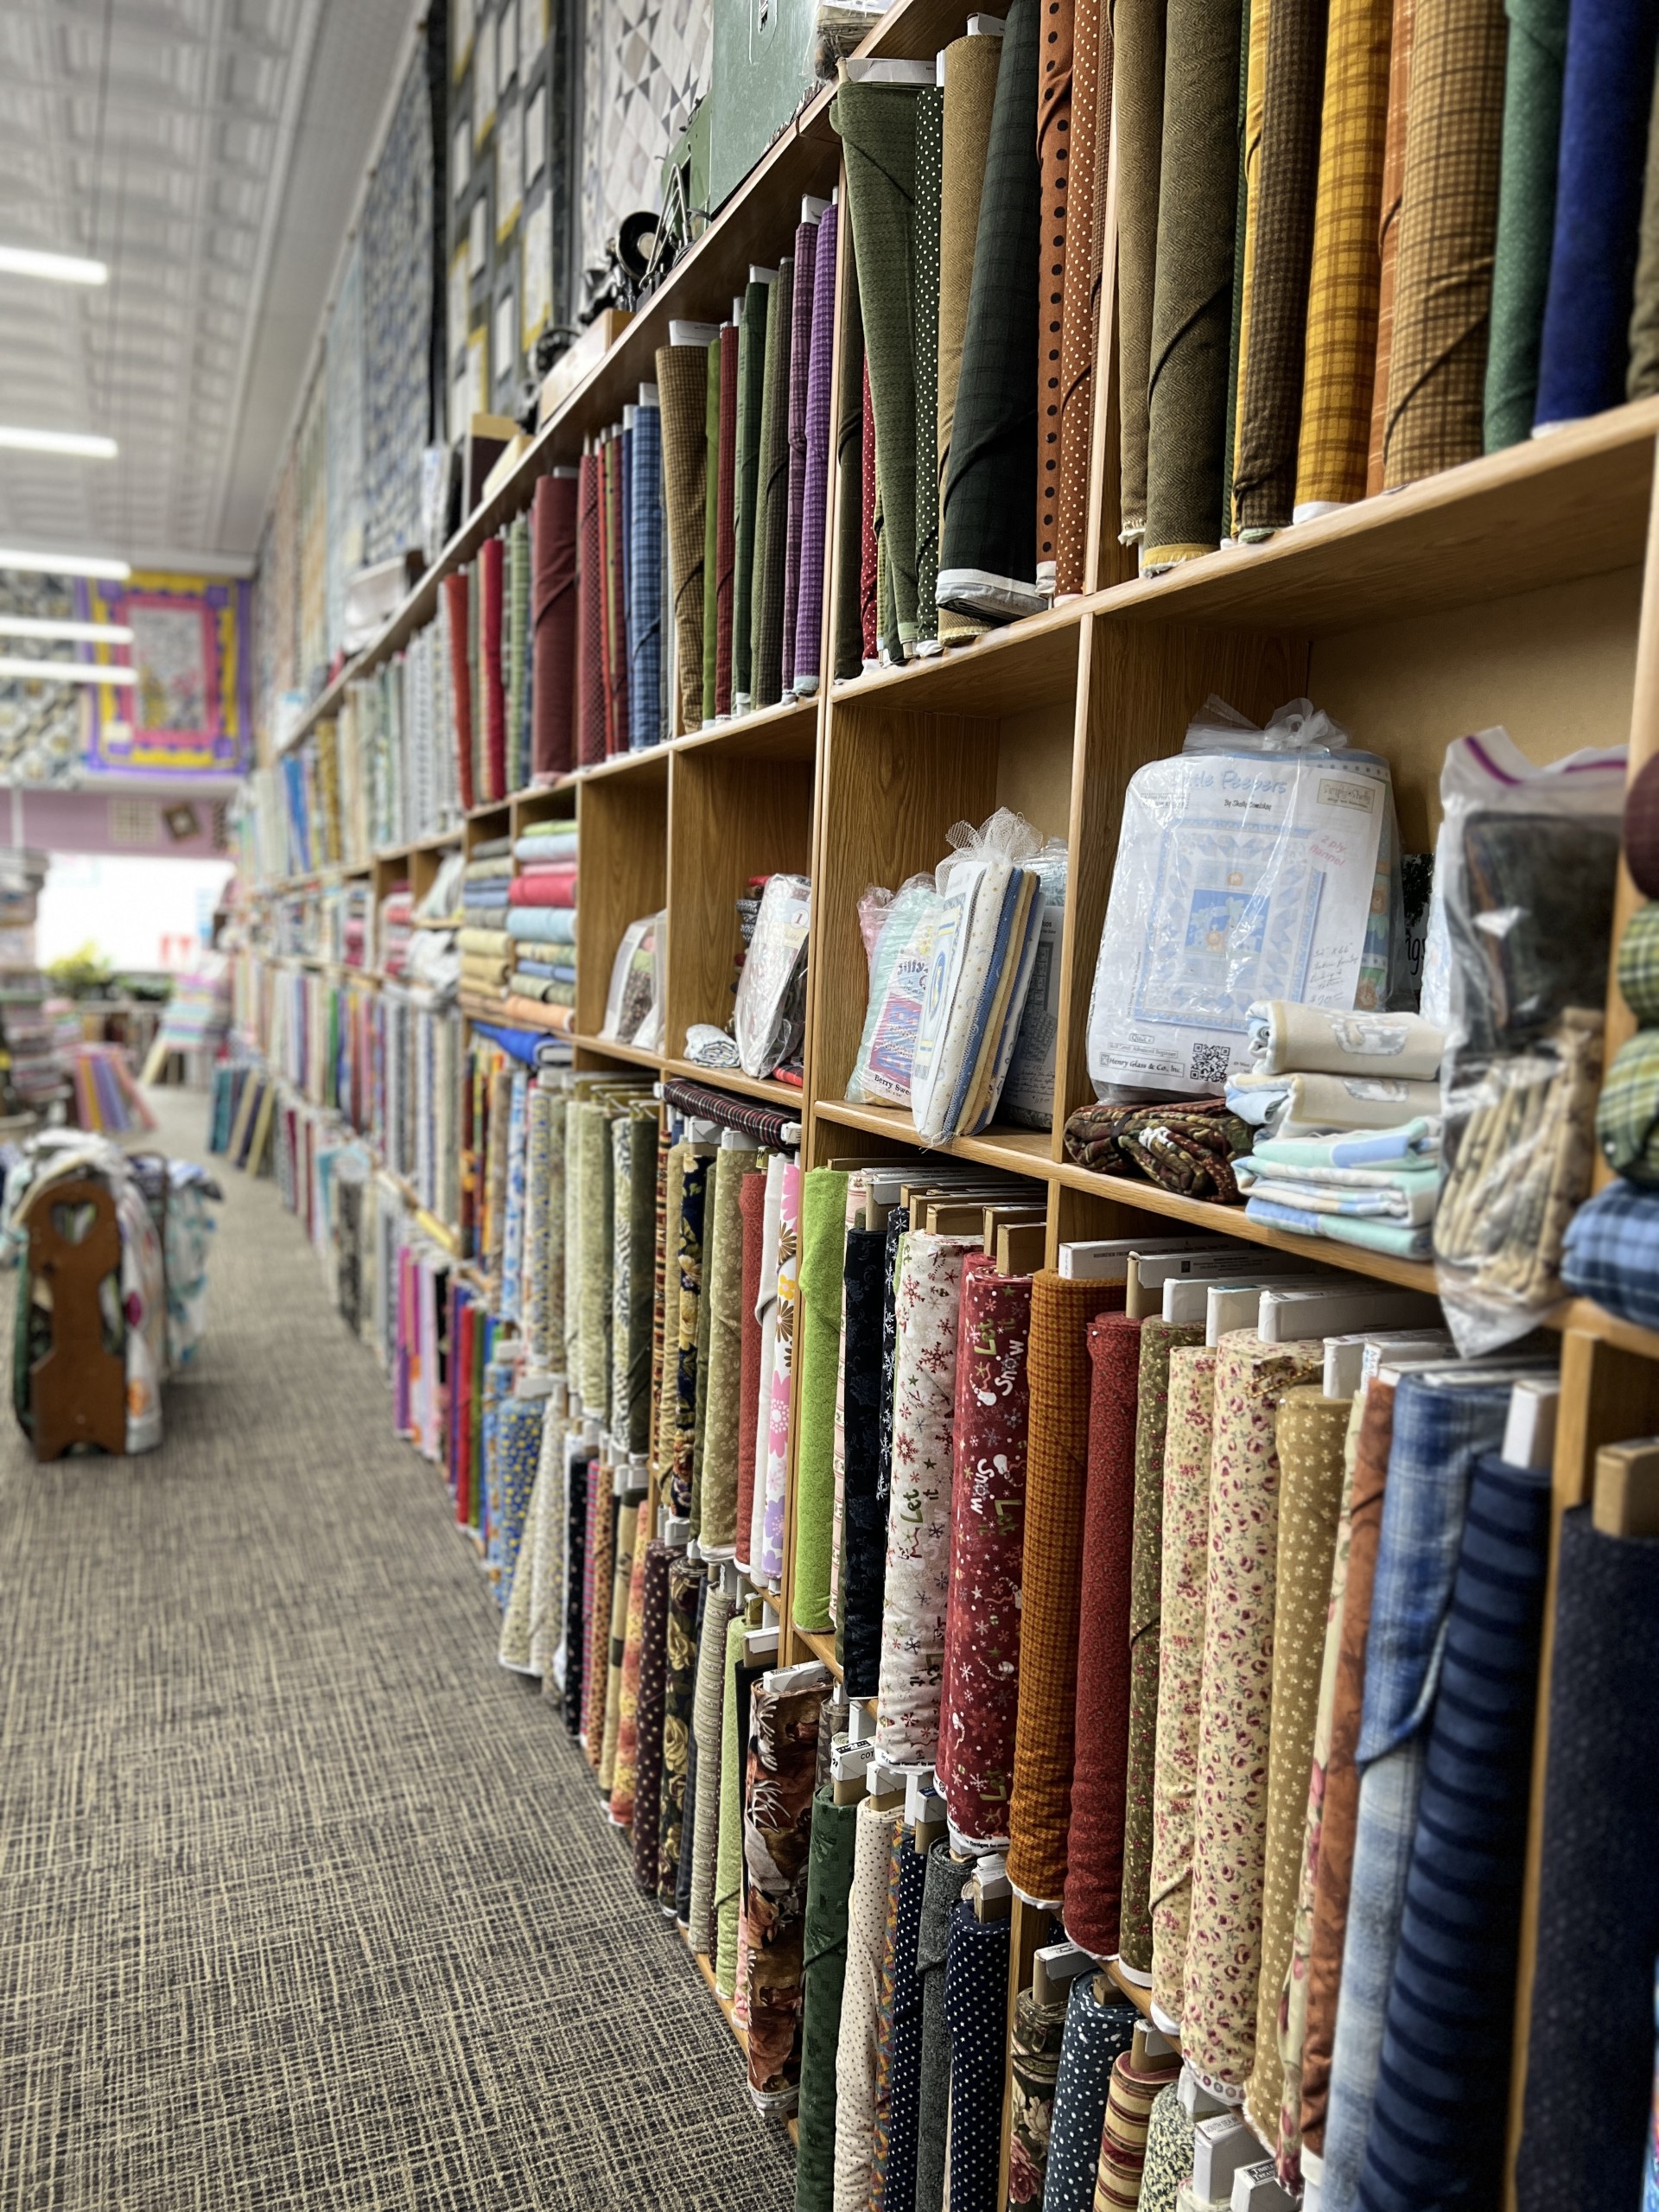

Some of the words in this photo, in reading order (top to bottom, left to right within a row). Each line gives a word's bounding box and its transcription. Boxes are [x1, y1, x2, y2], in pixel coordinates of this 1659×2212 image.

[1221, 770, 1287, 794] Peepers
[1321, 835, 1329, 843] 2
[1330, 839, 1347, 853] ply
[1310, 843, 1346, 868] flannel
[1109, 1058, 1128, 1068] Henry
[1129, 1059, 1147, 1068] Glass
[874, 1074, 893, 1089] Berry
[974, 1318, 996, 1356] Let
[900, 1489, 924, 1523] Let
[1204, 2121, 1222, 2133] SOUTH
